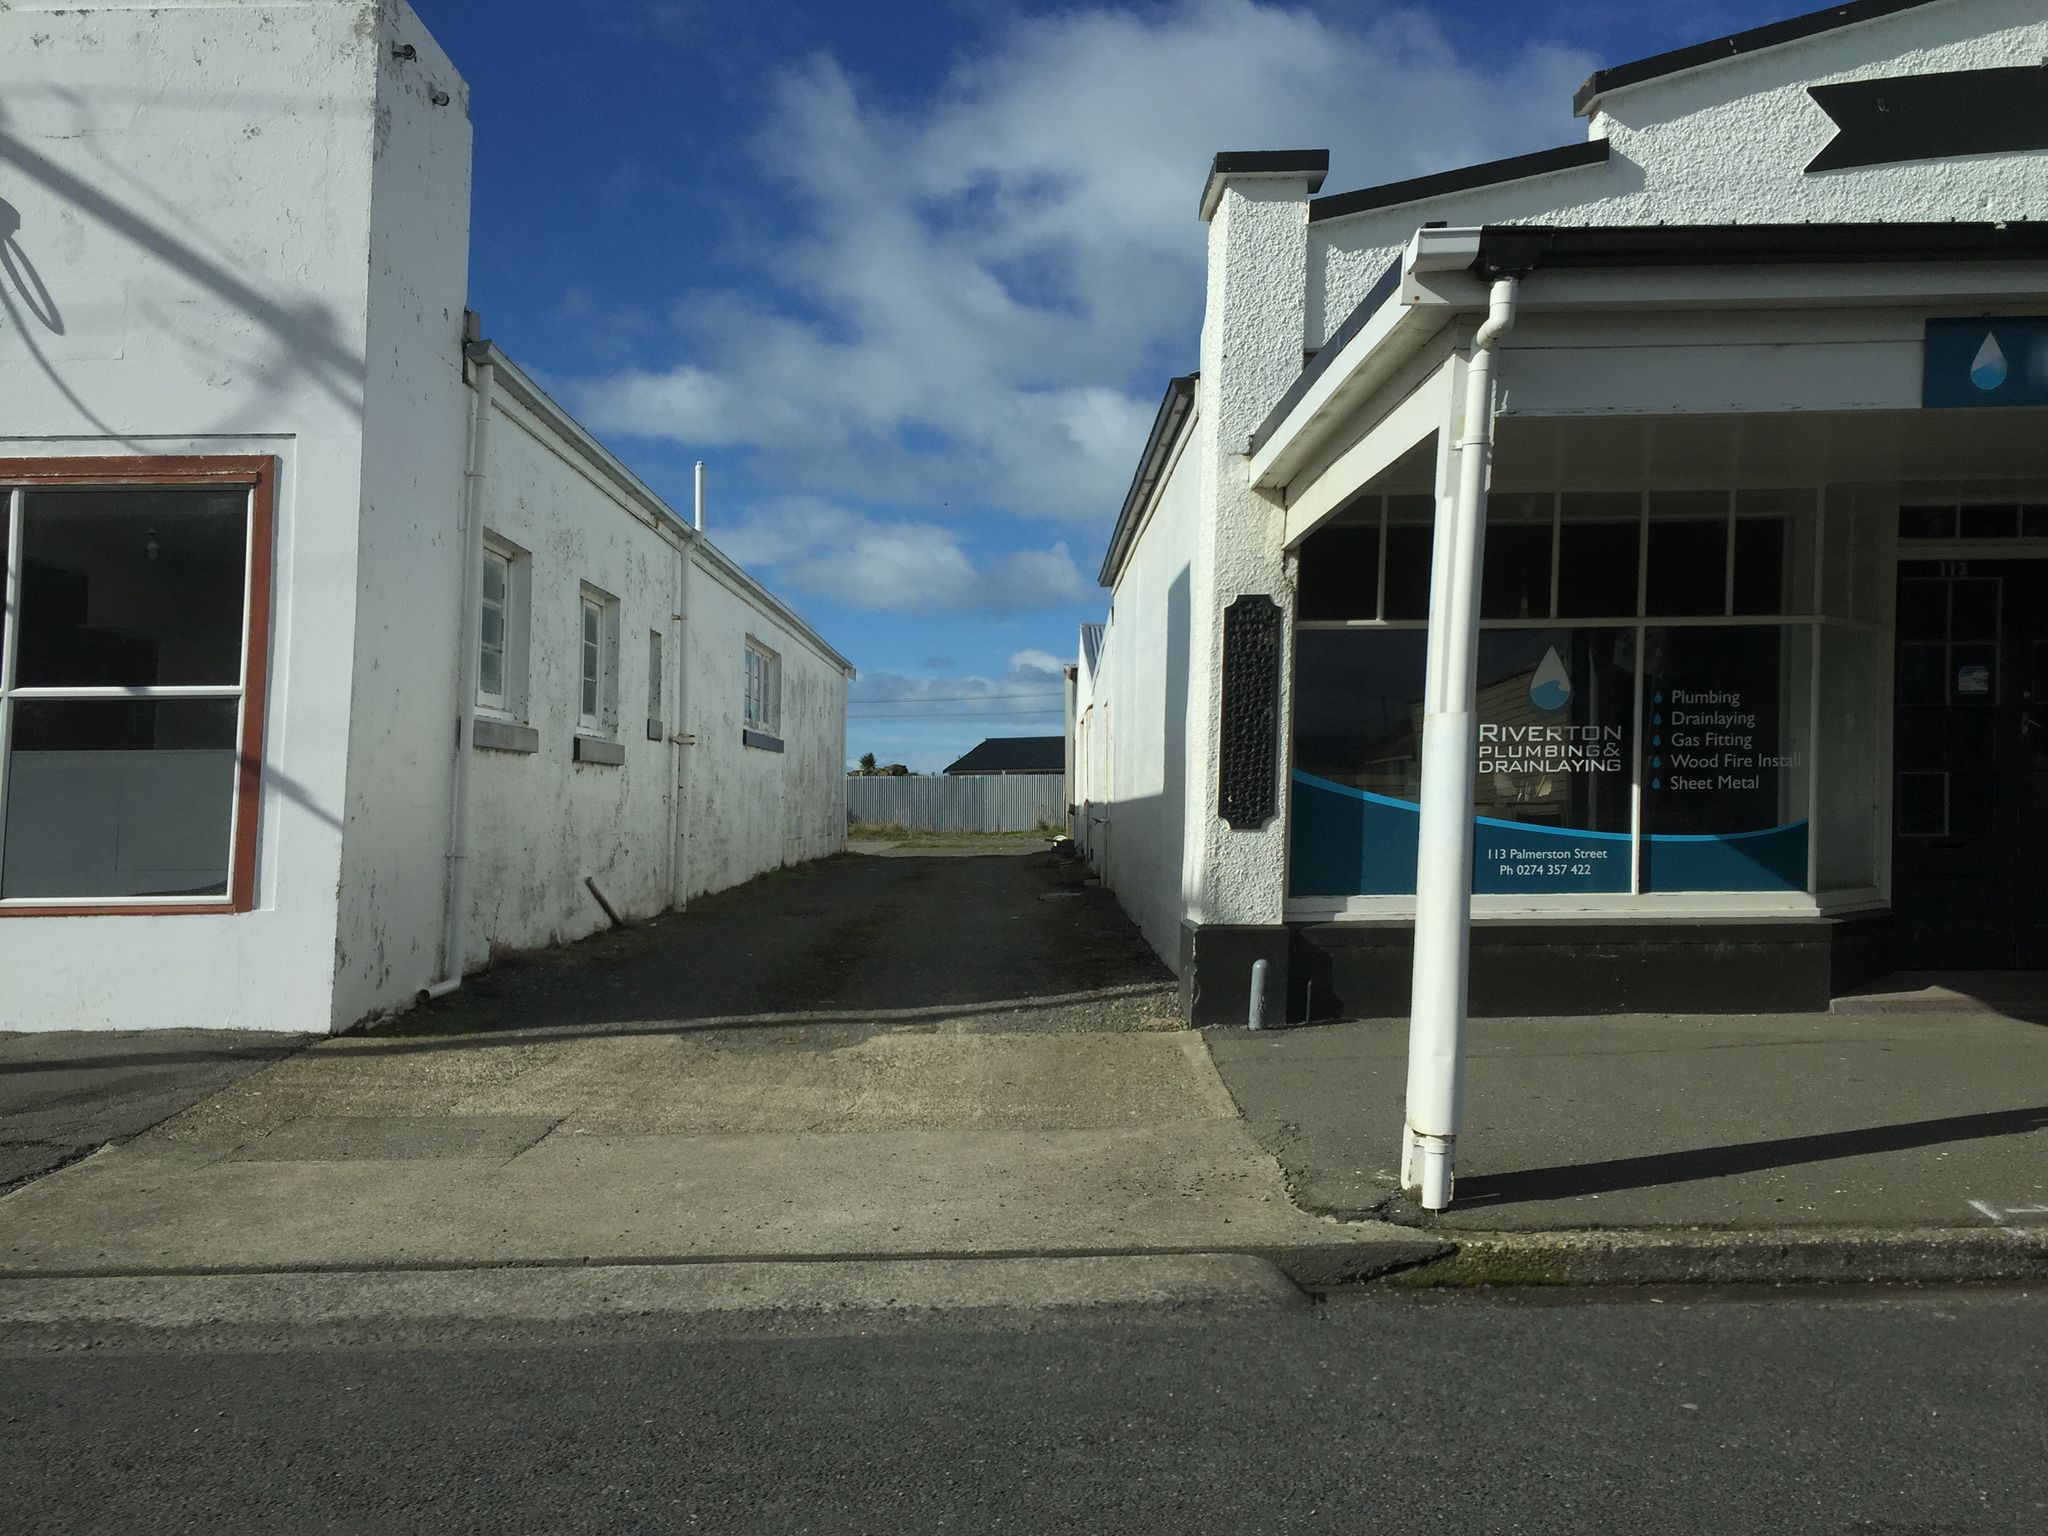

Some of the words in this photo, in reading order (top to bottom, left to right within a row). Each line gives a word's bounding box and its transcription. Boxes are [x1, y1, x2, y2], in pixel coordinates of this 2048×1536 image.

[1672, 690, 1741, 707] Plumbing
[1672, 711, 1756, 728] Drainlaying
[1479, 724, 1622, 742] RIVERTON
[1671, 733, 1700, 747] Gas
[1706, 732, 1752, 750] Fitting
[1479, 759, 1621, 773] DRAINLAYING
[1670, 754, 1718, 768] Wood
[1724, 754, 1753, 767] Fire
[1758, 753, 1801, 767] Install
[1670, 776, 1713, 790] Sheet
[1718, 775, 1759, 789] Metal
[1488, 849, 1506, 859] 113
[1510, 849, 1571, 859] Palmerston
[1575, 849, 1607, 859] Street
[1500, 865, 1513, 875] Ph
[1517, 865, 1543, 875] 0274
[1548, 865, 1567, 875] 357
[1571, 865, 1591, 875] 422
